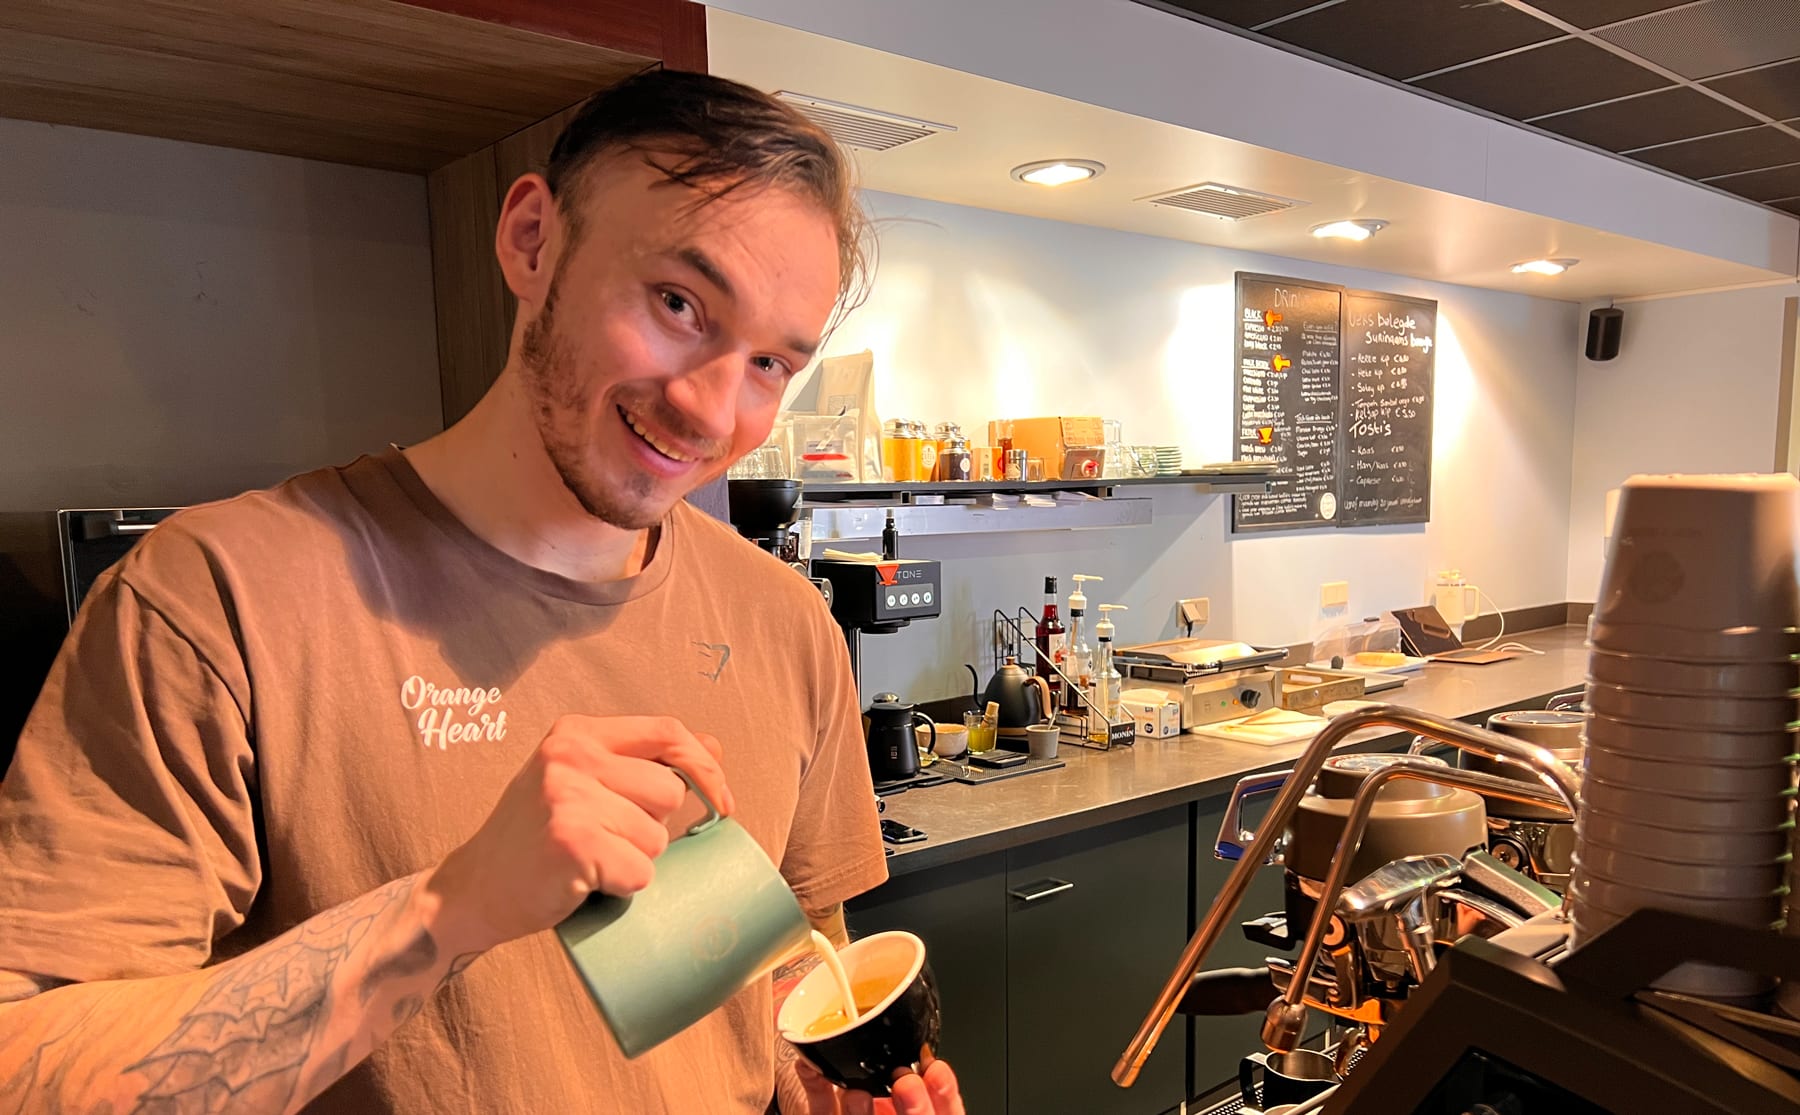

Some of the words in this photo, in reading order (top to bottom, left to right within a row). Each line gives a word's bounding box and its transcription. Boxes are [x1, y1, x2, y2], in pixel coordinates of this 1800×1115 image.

[1349, 420, 1392, 438] Tosti's
[401, 675, 502, 716] Orange
[418, 707, 507, 751] Heart
